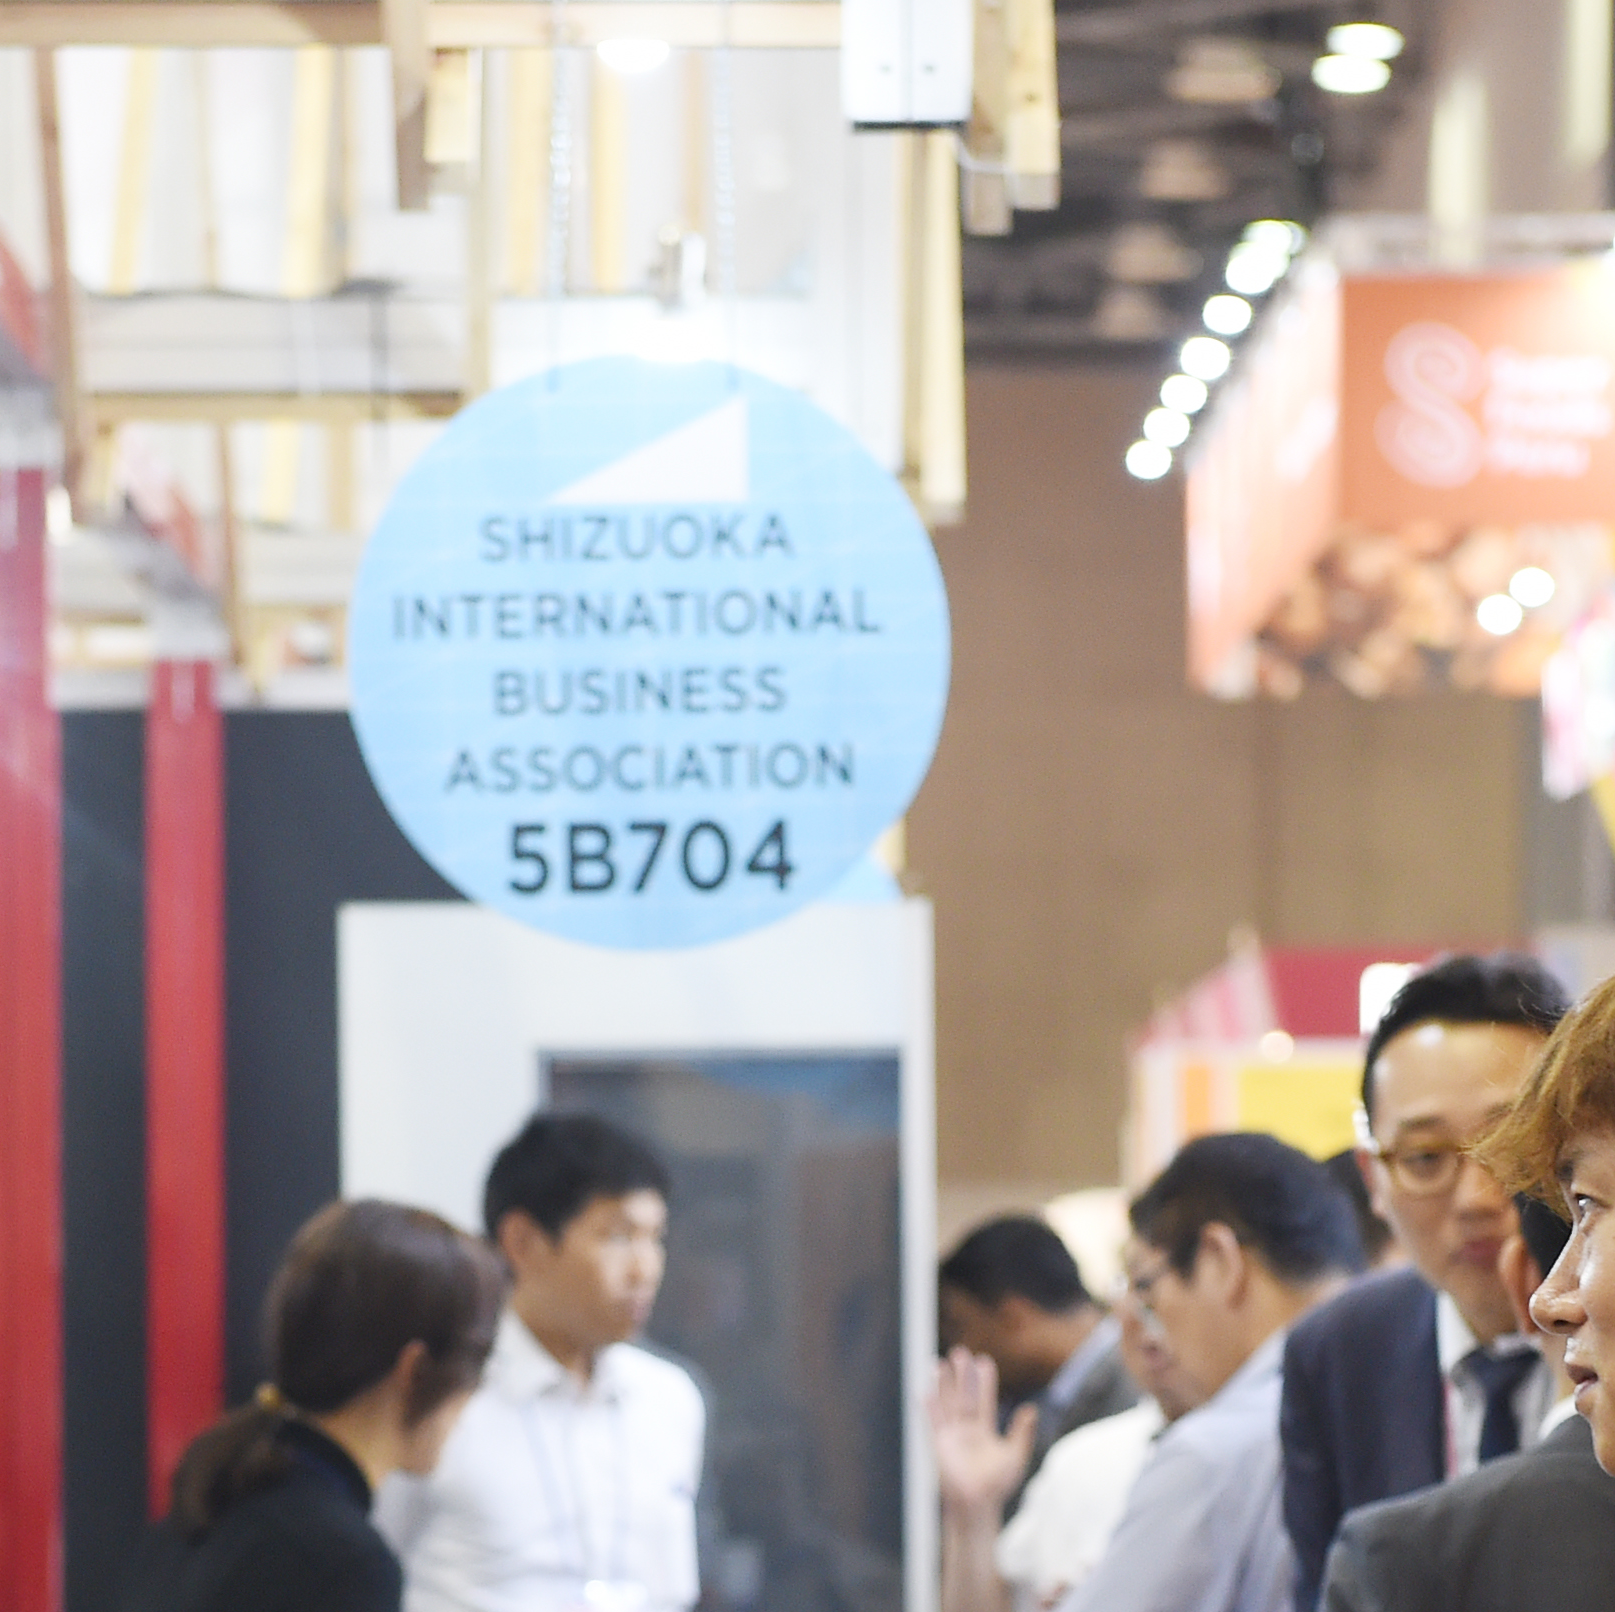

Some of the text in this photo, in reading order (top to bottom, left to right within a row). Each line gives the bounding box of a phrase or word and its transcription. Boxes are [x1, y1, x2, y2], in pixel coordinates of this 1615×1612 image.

[480, 513, 796, 562] SHIZUOKA
[392, 588, 881, 640] INTERNATIONAL
[494, 666, 787, 717] BUSINESS
[445, 743, 856, 794] ASSOCIATION
[509, 820, 795, 893] 5B704
